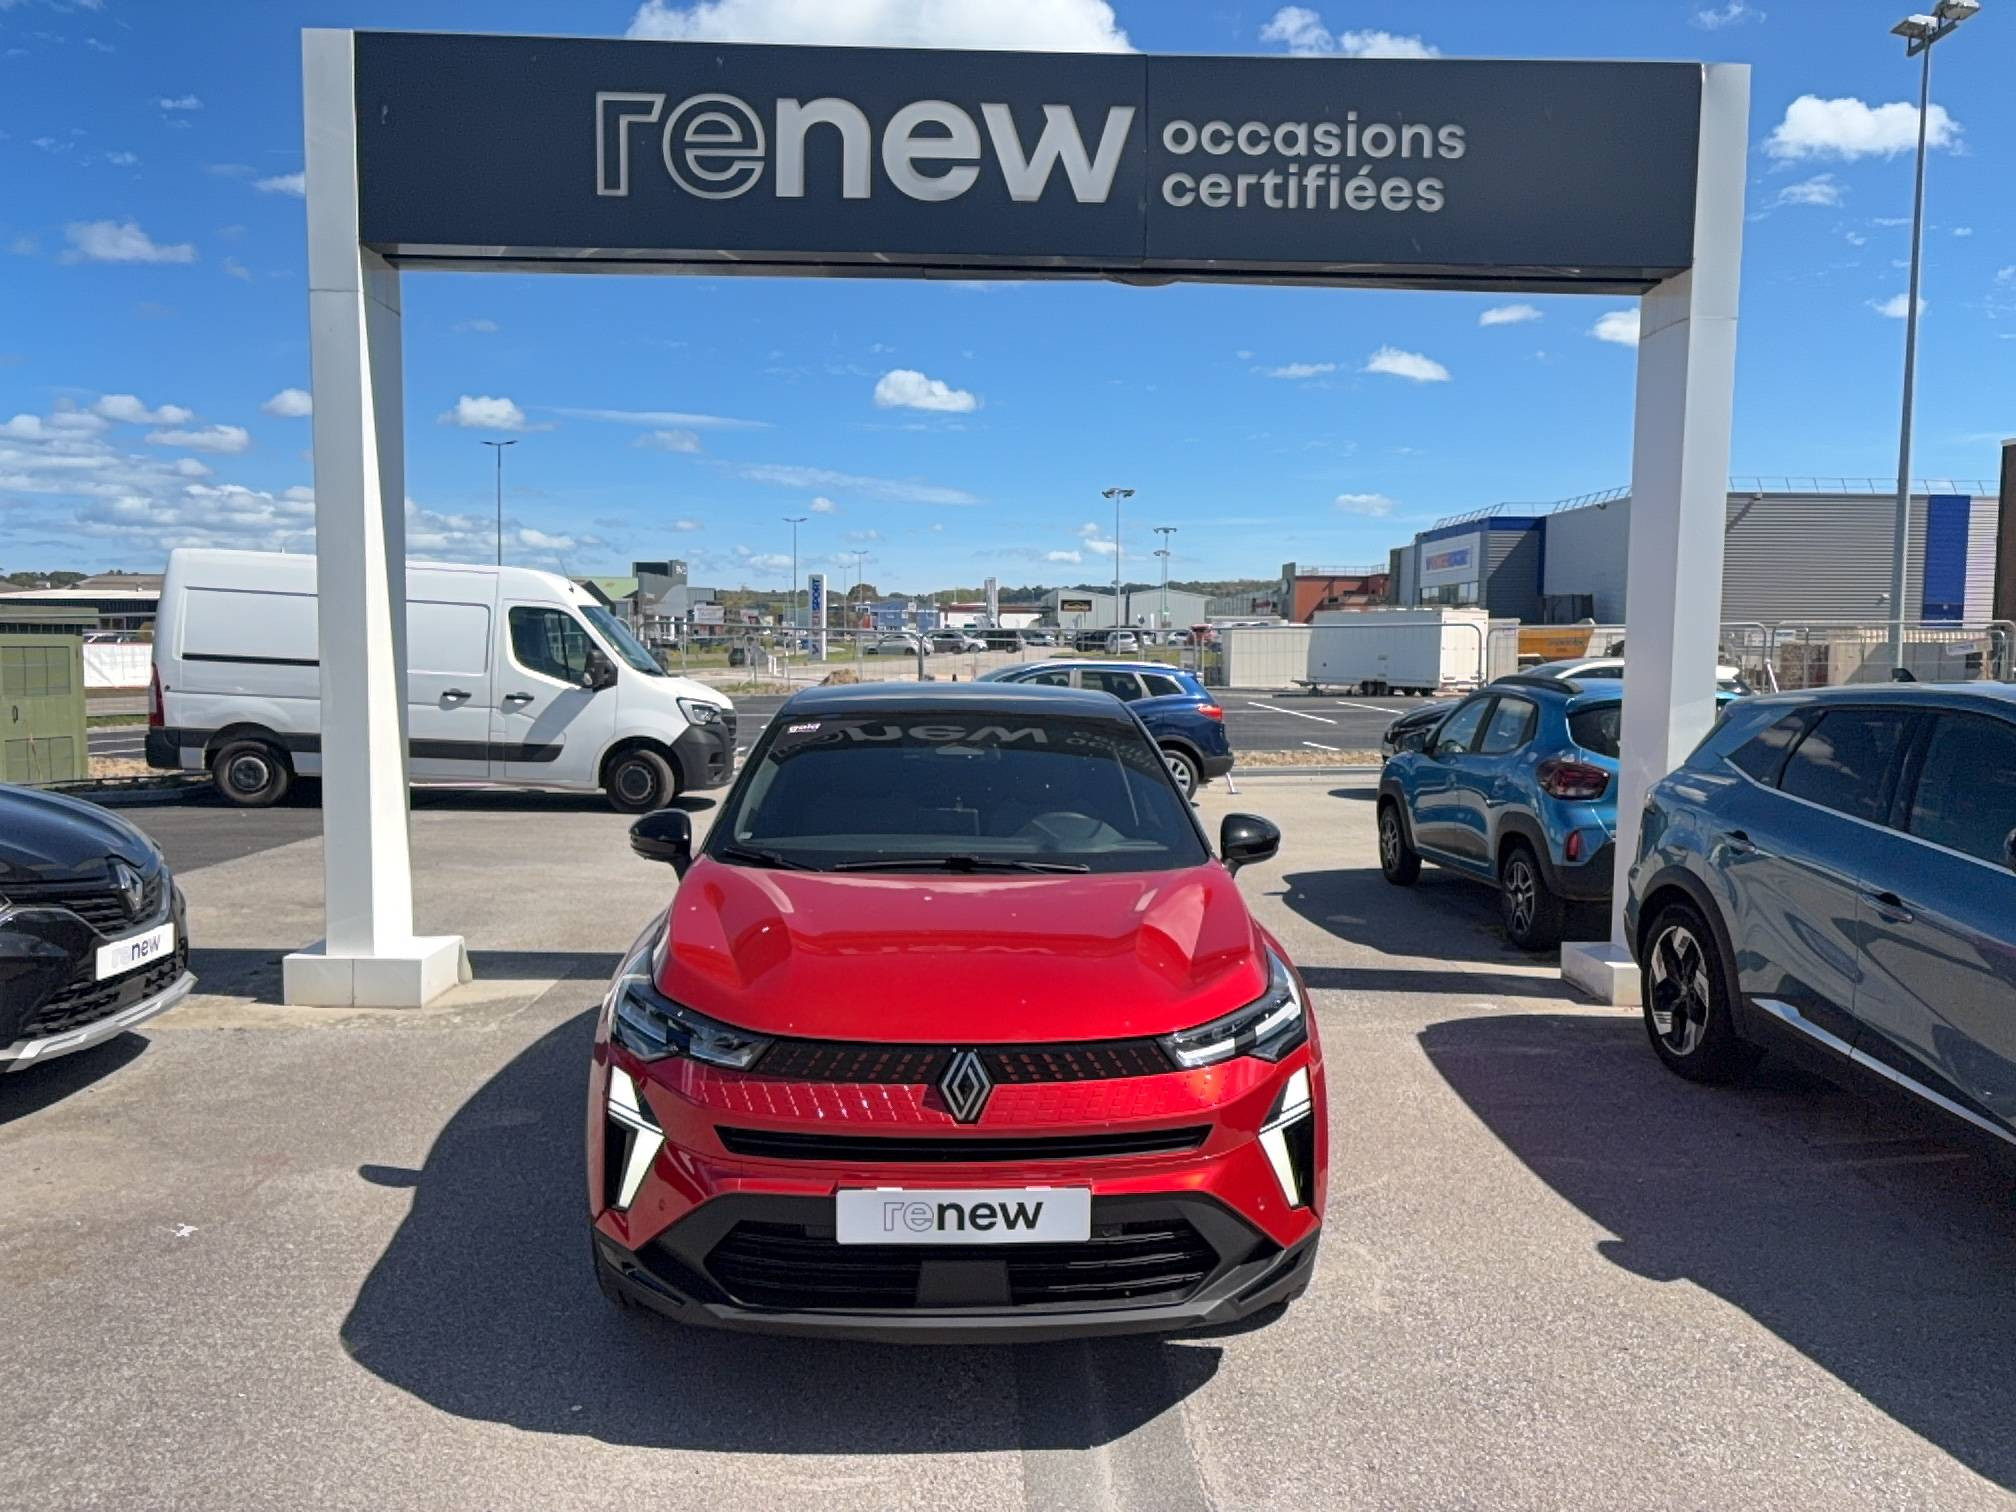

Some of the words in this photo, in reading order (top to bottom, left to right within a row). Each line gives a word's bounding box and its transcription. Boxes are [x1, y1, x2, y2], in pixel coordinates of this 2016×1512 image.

[596, 92, 1136, 202] renew
[1162, 111, 1466, 159] occasions
[1162, 163, 1445, 212] certifiées
[884, 1202, 1044, 1232] renew
